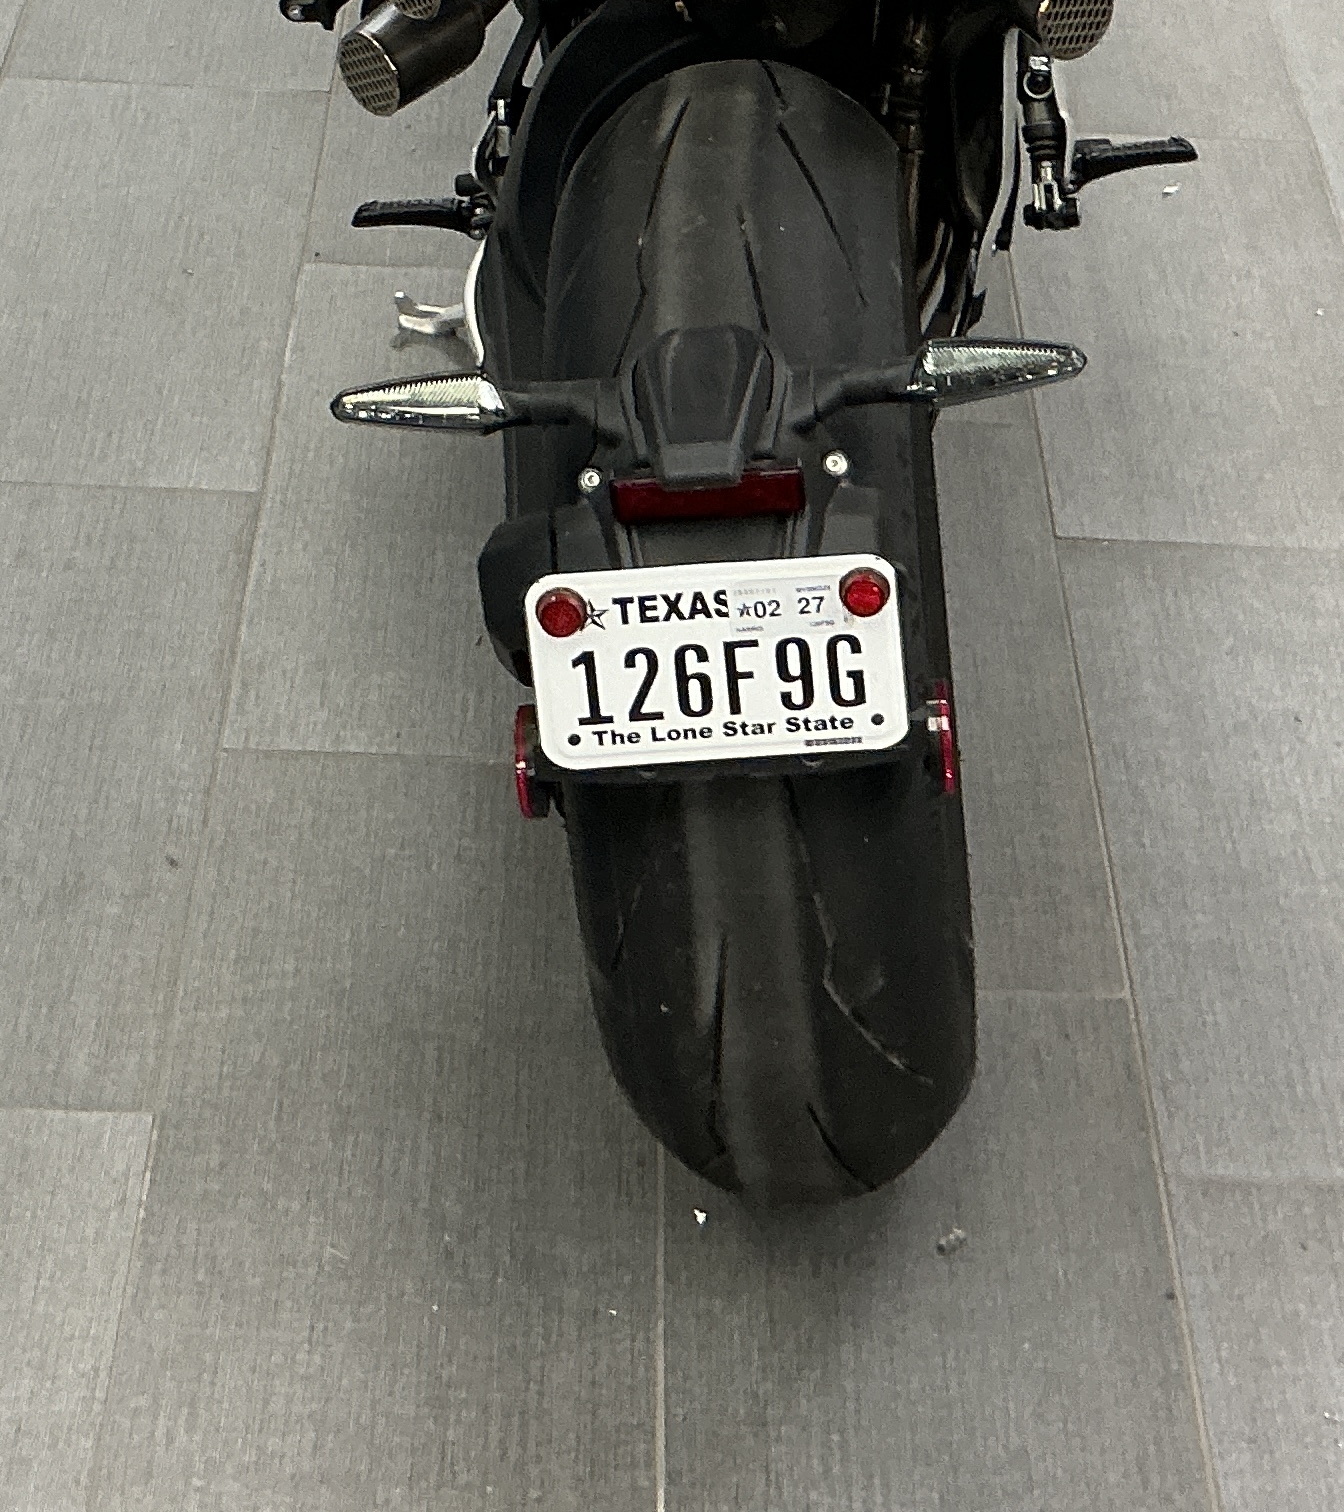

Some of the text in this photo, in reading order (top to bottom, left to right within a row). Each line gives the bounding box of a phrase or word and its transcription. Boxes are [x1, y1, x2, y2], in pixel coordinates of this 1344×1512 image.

[612, 589, 825, 626] TEXAS 02 27
[571, 634, 867, 726] 126F9G
[592, 714, 855, 747] The Lone Star State
